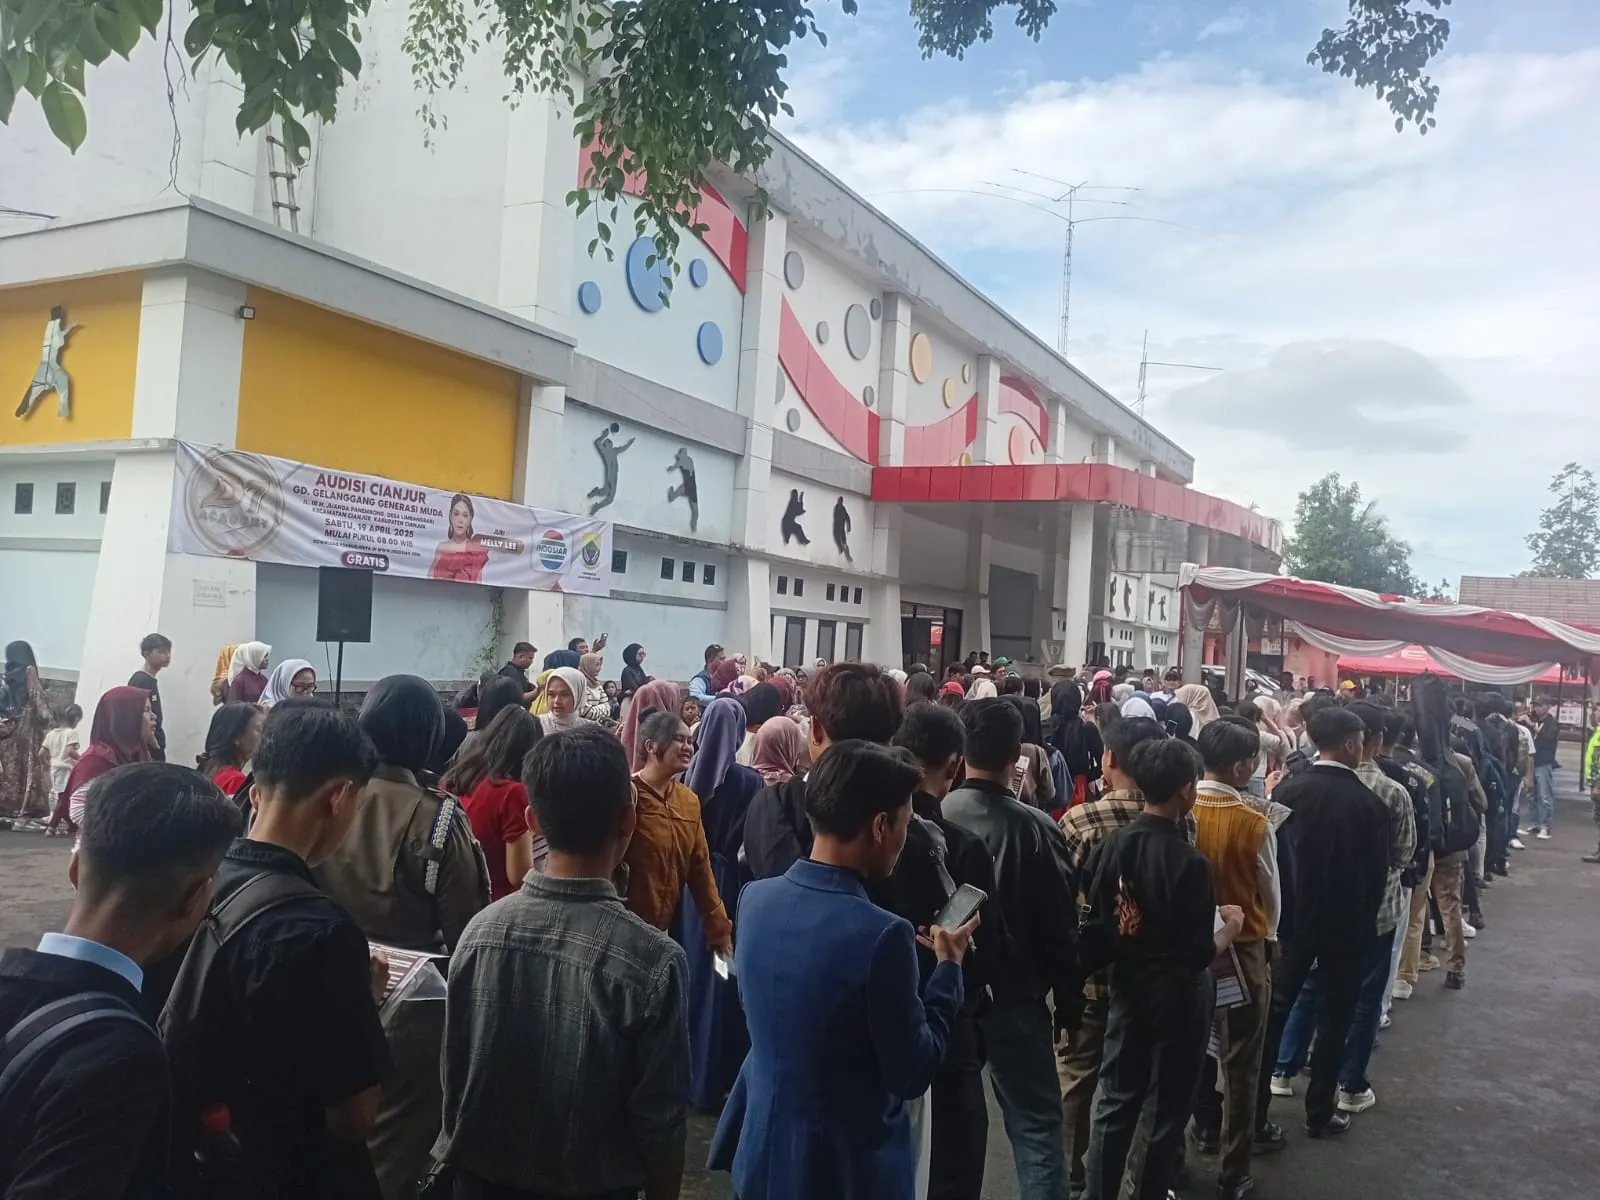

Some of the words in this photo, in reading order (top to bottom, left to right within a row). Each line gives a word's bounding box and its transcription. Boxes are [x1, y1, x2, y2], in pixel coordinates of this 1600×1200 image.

[316, 473, 366, 494] AUDISI
[370, 483, 426, 504] CIANJUR
[293, 485, 310, 496] GD.
[312, 488, 376, 506] GELANGGANG
[378, 499, 418, 513] GENERASI
[420, 507, 443, 517] MUDA
[326, 502, 349, 511] JUANDA
[313, 507, 346, 516] KECAMATAN
[374, 517, 403, 525] KABUPATEN
[405, 521, 426, 529] CIANJUR
[324, 518, 355, 531] SABTU,
[358, 522, 367, 531] 19
[369, 524, 392, 535] APRIL
[394, 528, 414, 538] 2025
[324, 529, 351, 540] MULAI
[352, 533, 375, 543] PUKUL
[400, 539, 414, 548] WIB
[480, 538, 504, 550] MELLY
[504, 541, 517, 550] LEE
[536, 544, 568, 555] INDOSIAR
[346, 554, 386, 568] GRATIS
